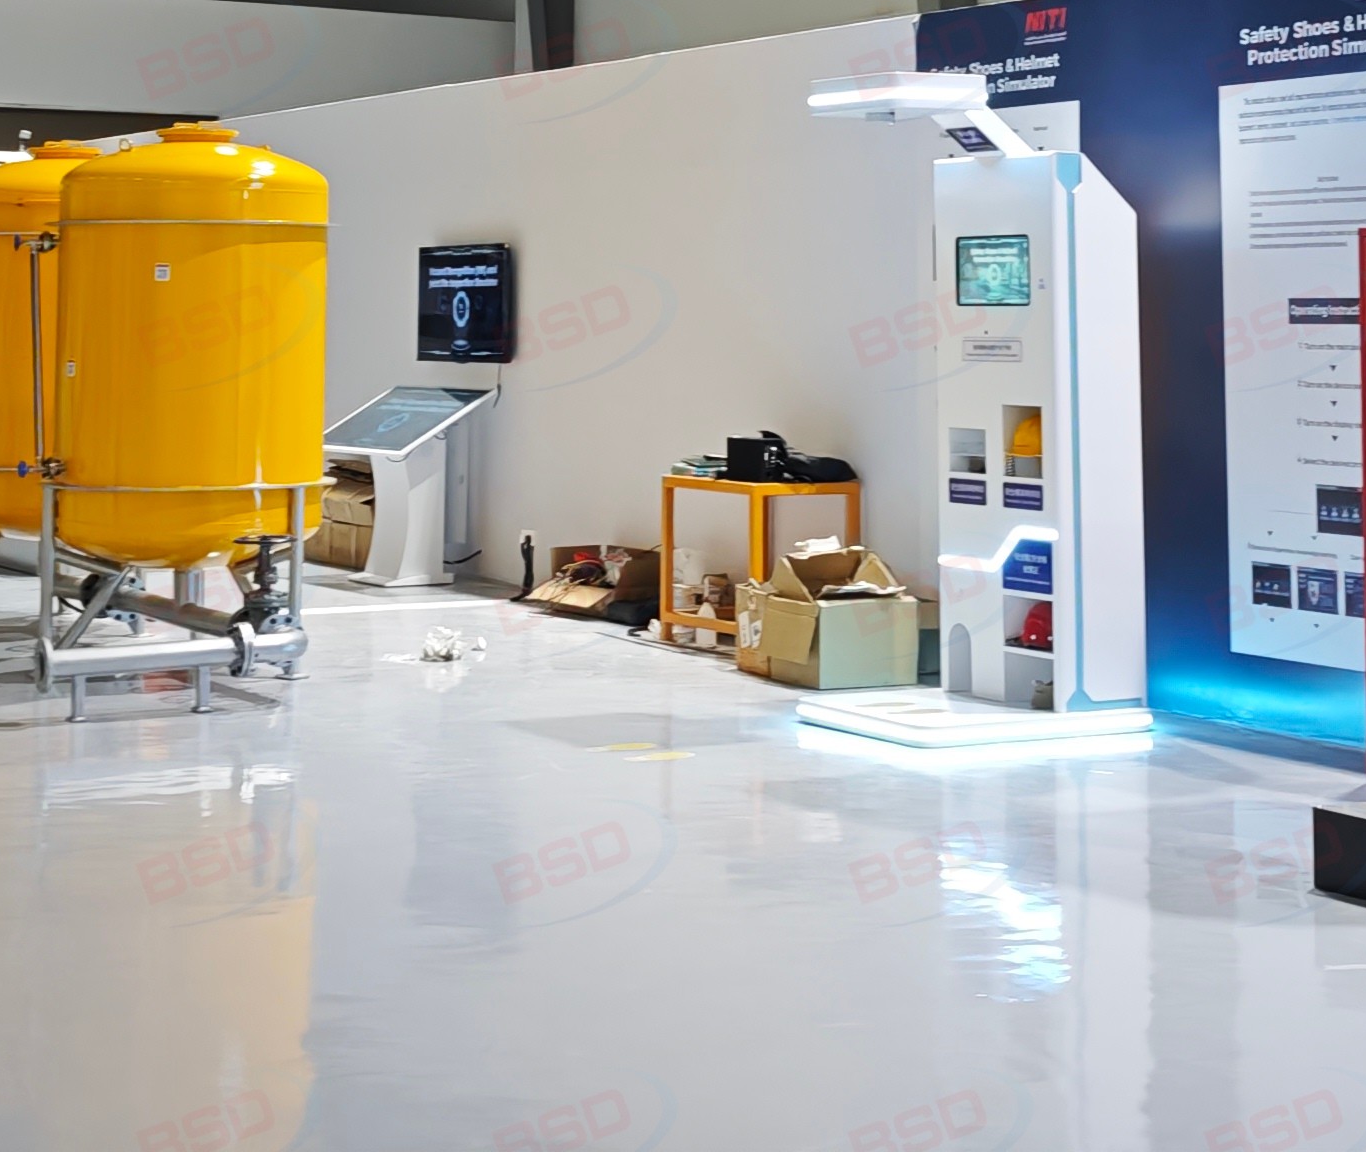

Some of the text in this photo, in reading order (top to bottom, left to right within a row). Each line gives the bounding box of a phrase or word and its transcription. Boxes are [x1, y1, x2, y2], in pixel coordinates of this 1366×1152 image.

[1239, 26, 1289, 45] Safety
[1292, 20, 1340, 39] Shoes
[1343, 16, 1355, 32] &
[1005, 58, 1014, 73] &
[1014, 53, 1060, 72] Helmet
[1247, 41, 1330, 66] Protection
[996, 75, 1056, 94] Simulator
